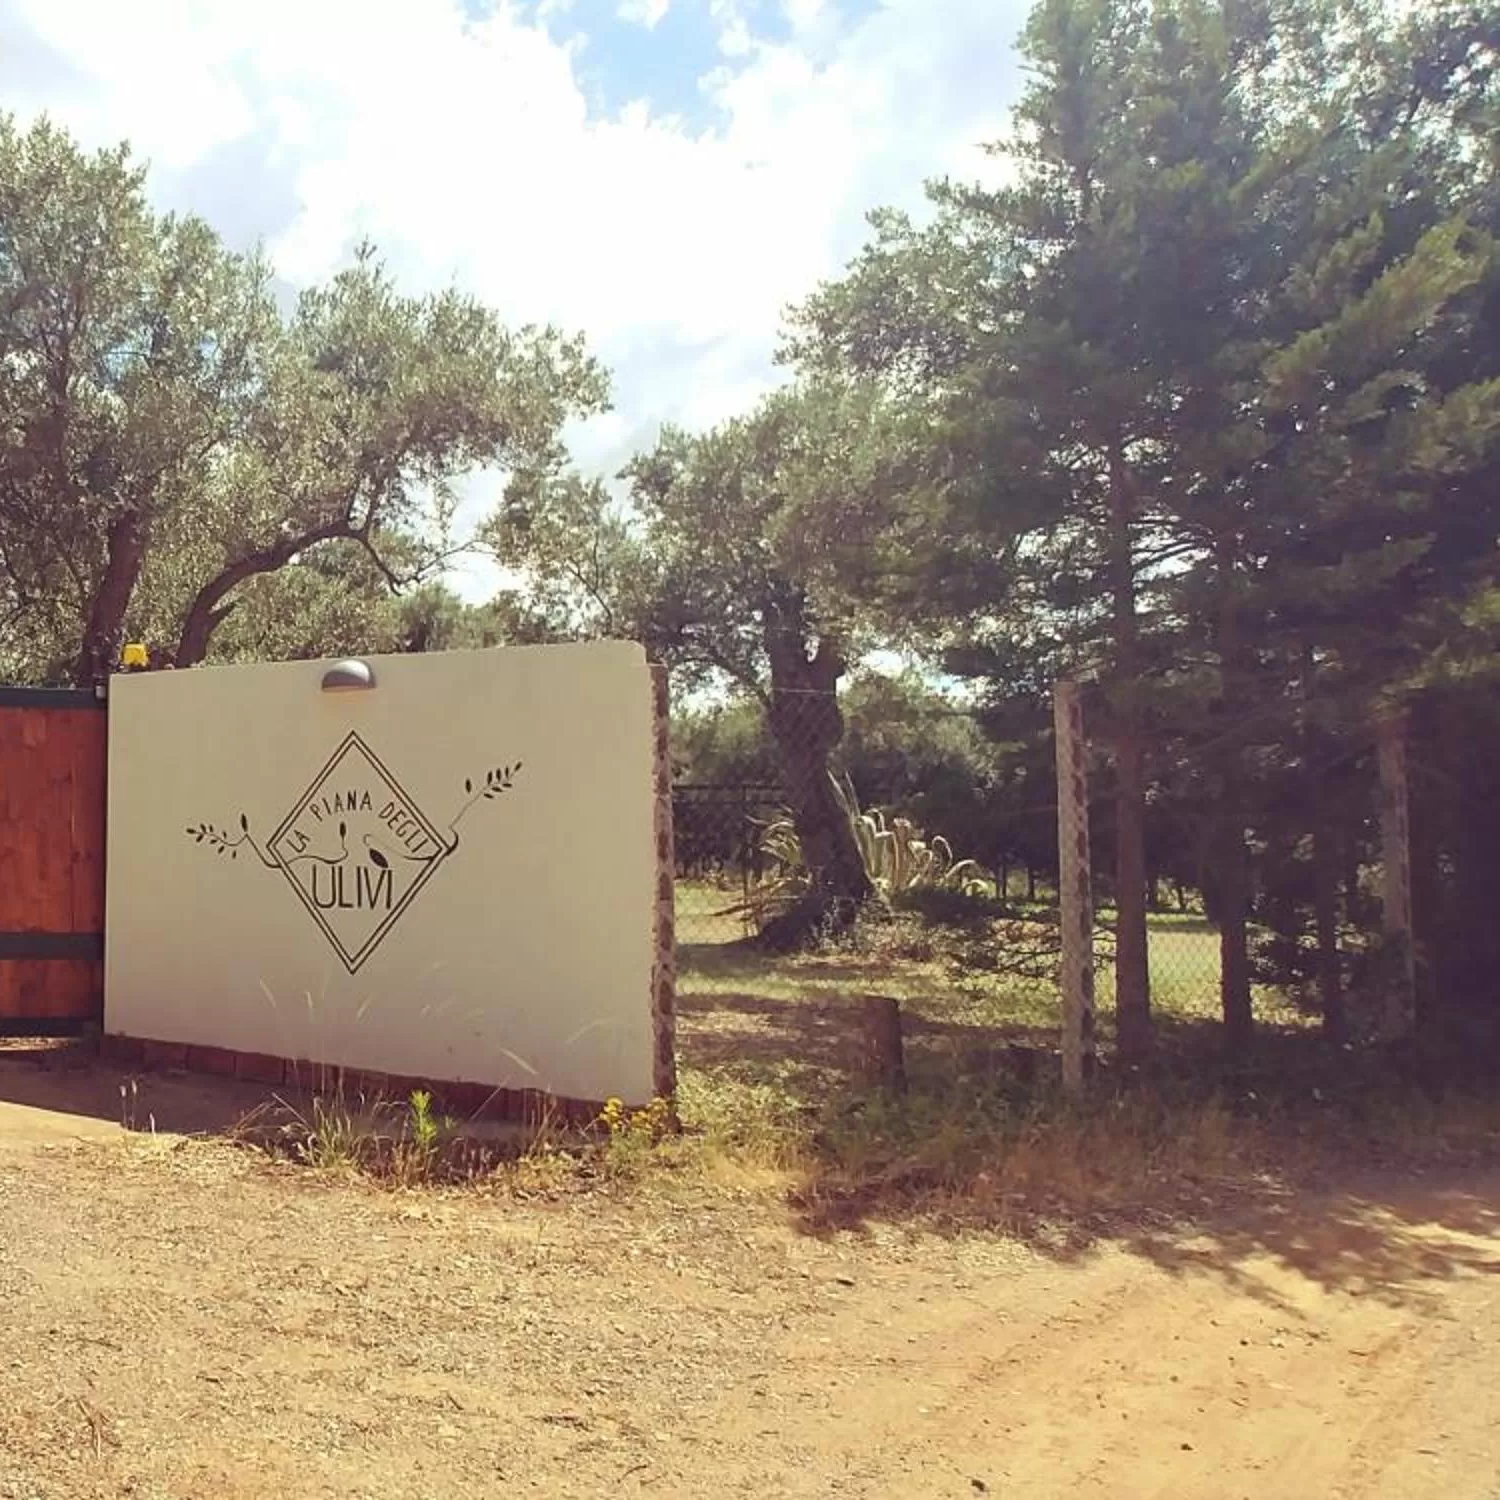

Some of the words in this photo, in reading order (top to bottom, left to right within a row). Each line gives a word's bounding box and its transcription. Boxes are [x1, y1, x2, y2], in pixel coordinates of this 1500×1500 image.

[285, 829, 311, 854] LA
[309, 790, 373, 822] PIANA
[378, 801, 429, 854] DEGLI
[312, 864, 392, 909] ULIVI
